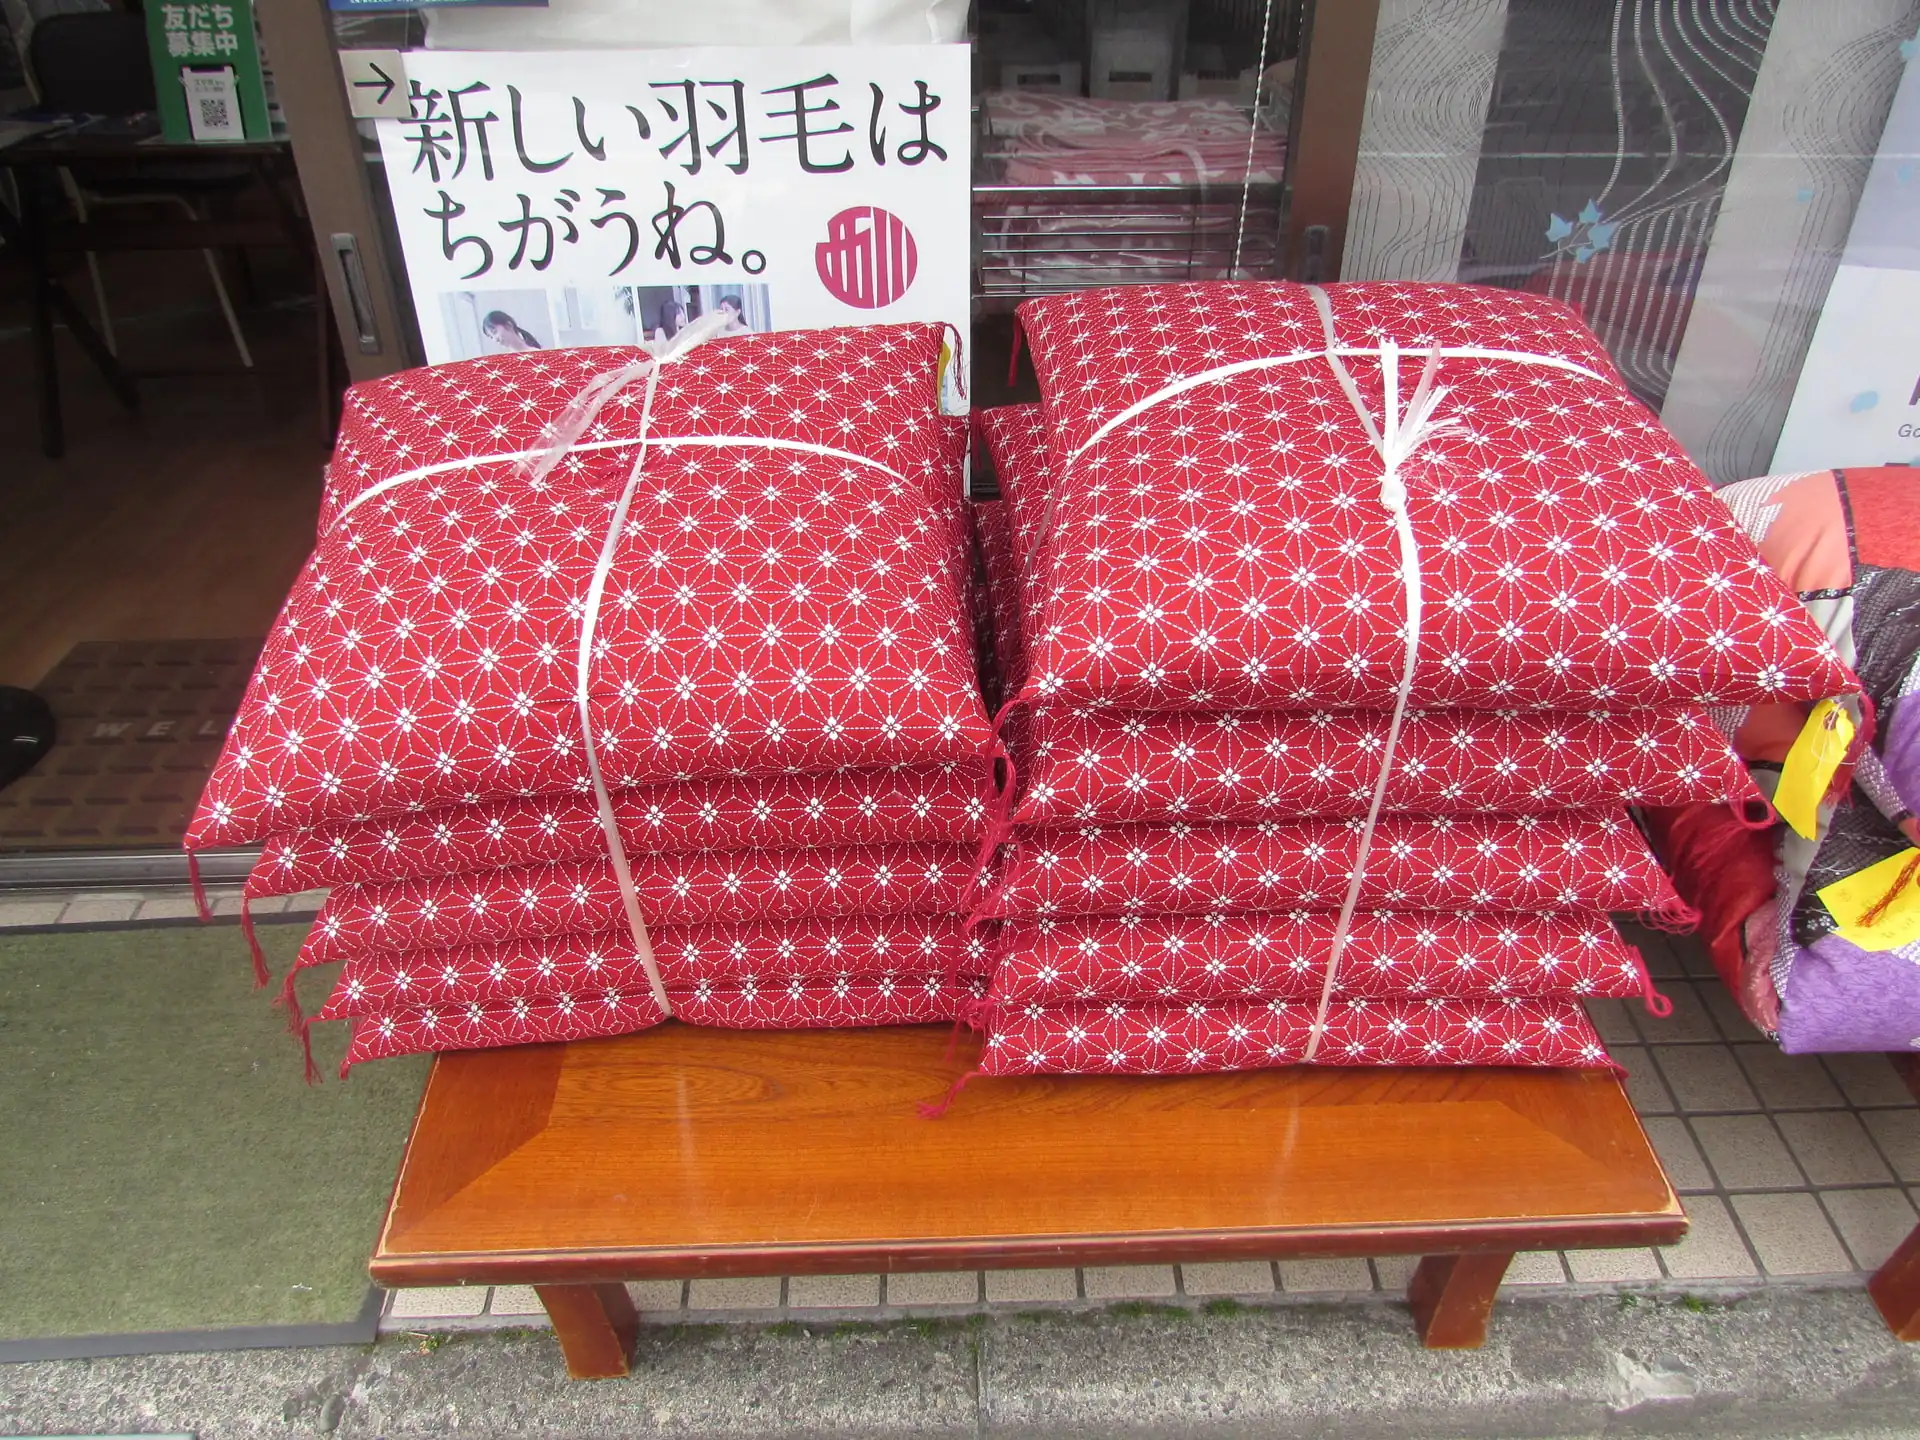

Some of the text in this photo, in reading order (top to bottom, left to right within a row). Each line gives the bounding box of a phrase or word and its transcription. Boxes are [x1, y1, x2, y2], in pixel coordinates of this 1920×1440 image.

[161, 4, 234, 30] 友だち
[165, 30, 238, 57] 募集中
[398, 73, 948, 183] 新しい羽毛は
[423, 180, 766, 280] ちがうね。
